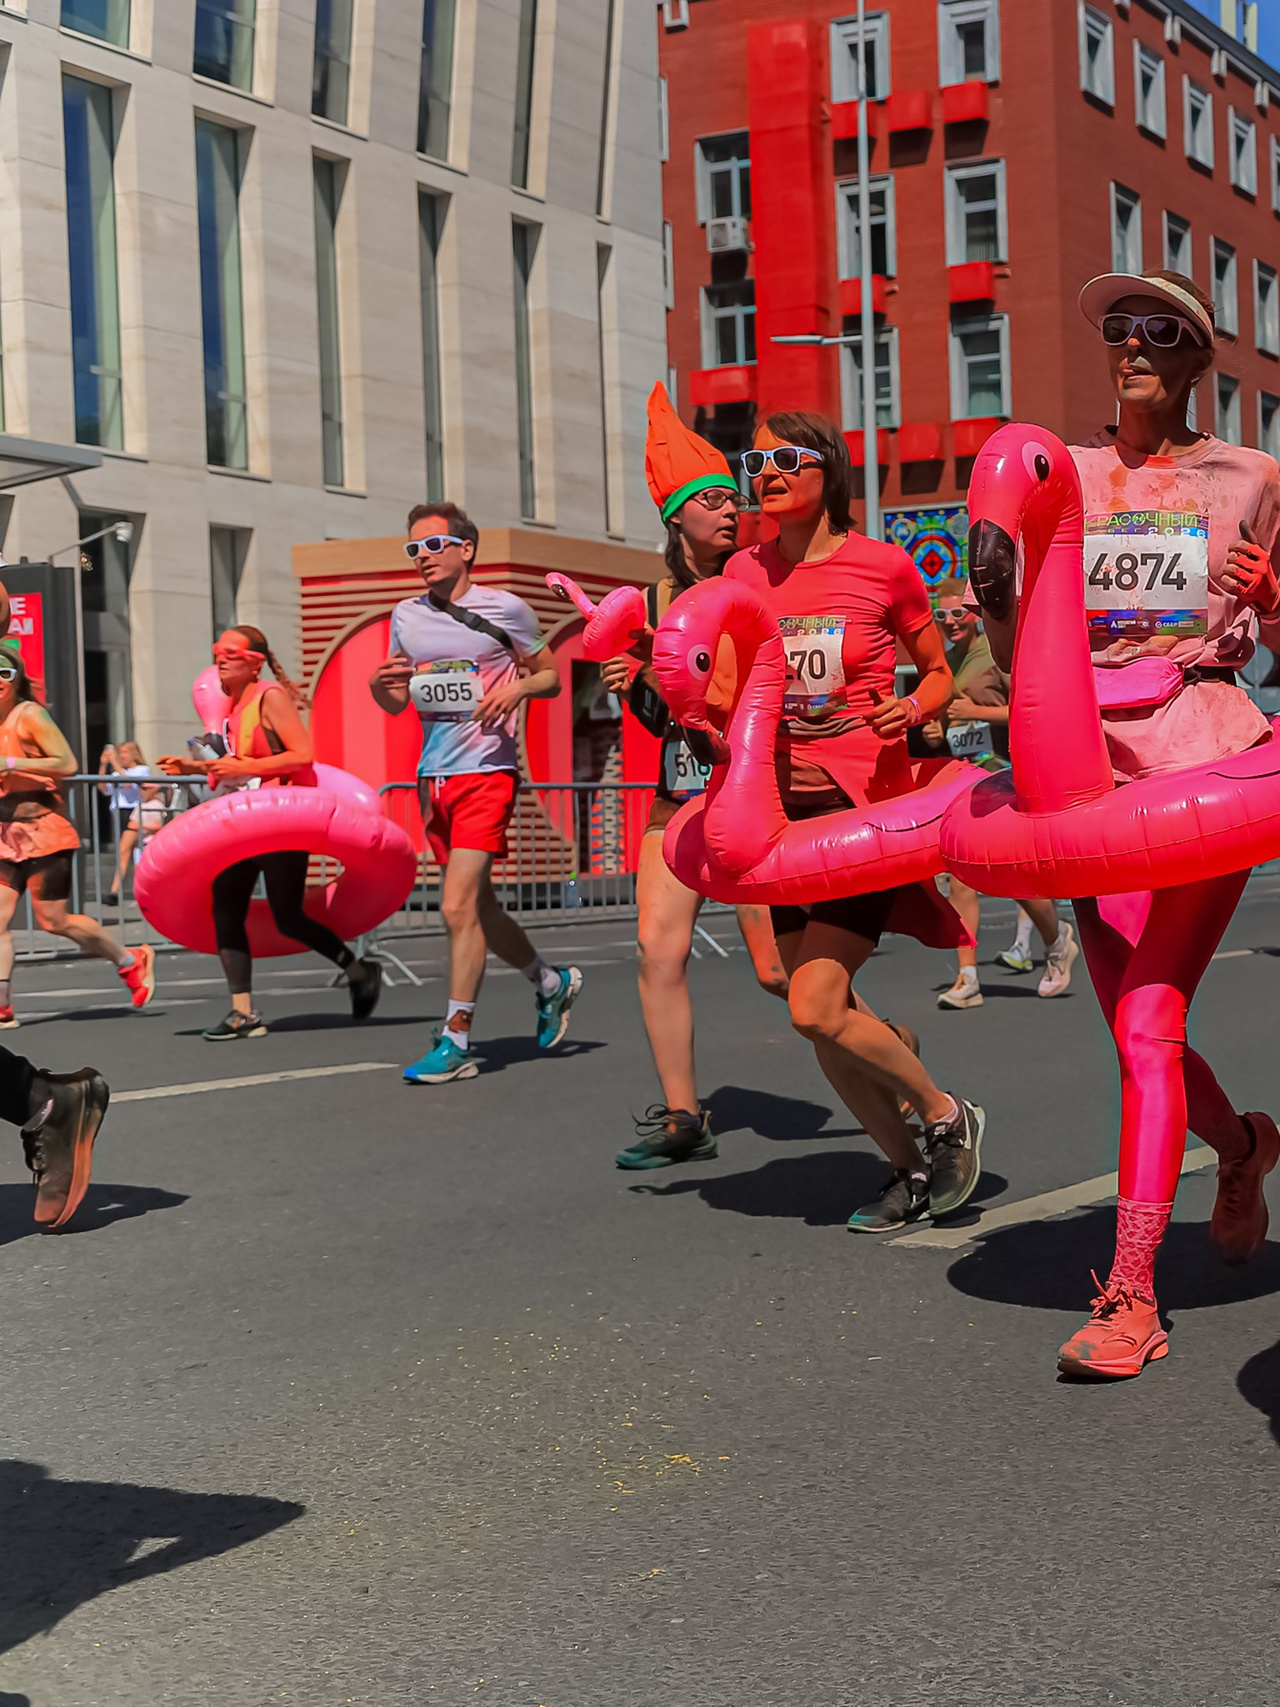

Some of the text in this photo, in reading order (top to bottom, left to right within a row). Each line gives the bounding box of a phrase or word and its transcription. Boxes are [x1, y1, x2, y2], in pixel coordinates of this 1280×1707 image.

[1084, 512, 1198, 529] КРАСОЧНЫЙ
[1147, 526, 1207, 539] 2026
[1088, 553, 1188, 591] 4874
[785, 649, 826, 680] 70
[420, 683, 473, 703] 3055
[952, 731, 984, 748] 3072
